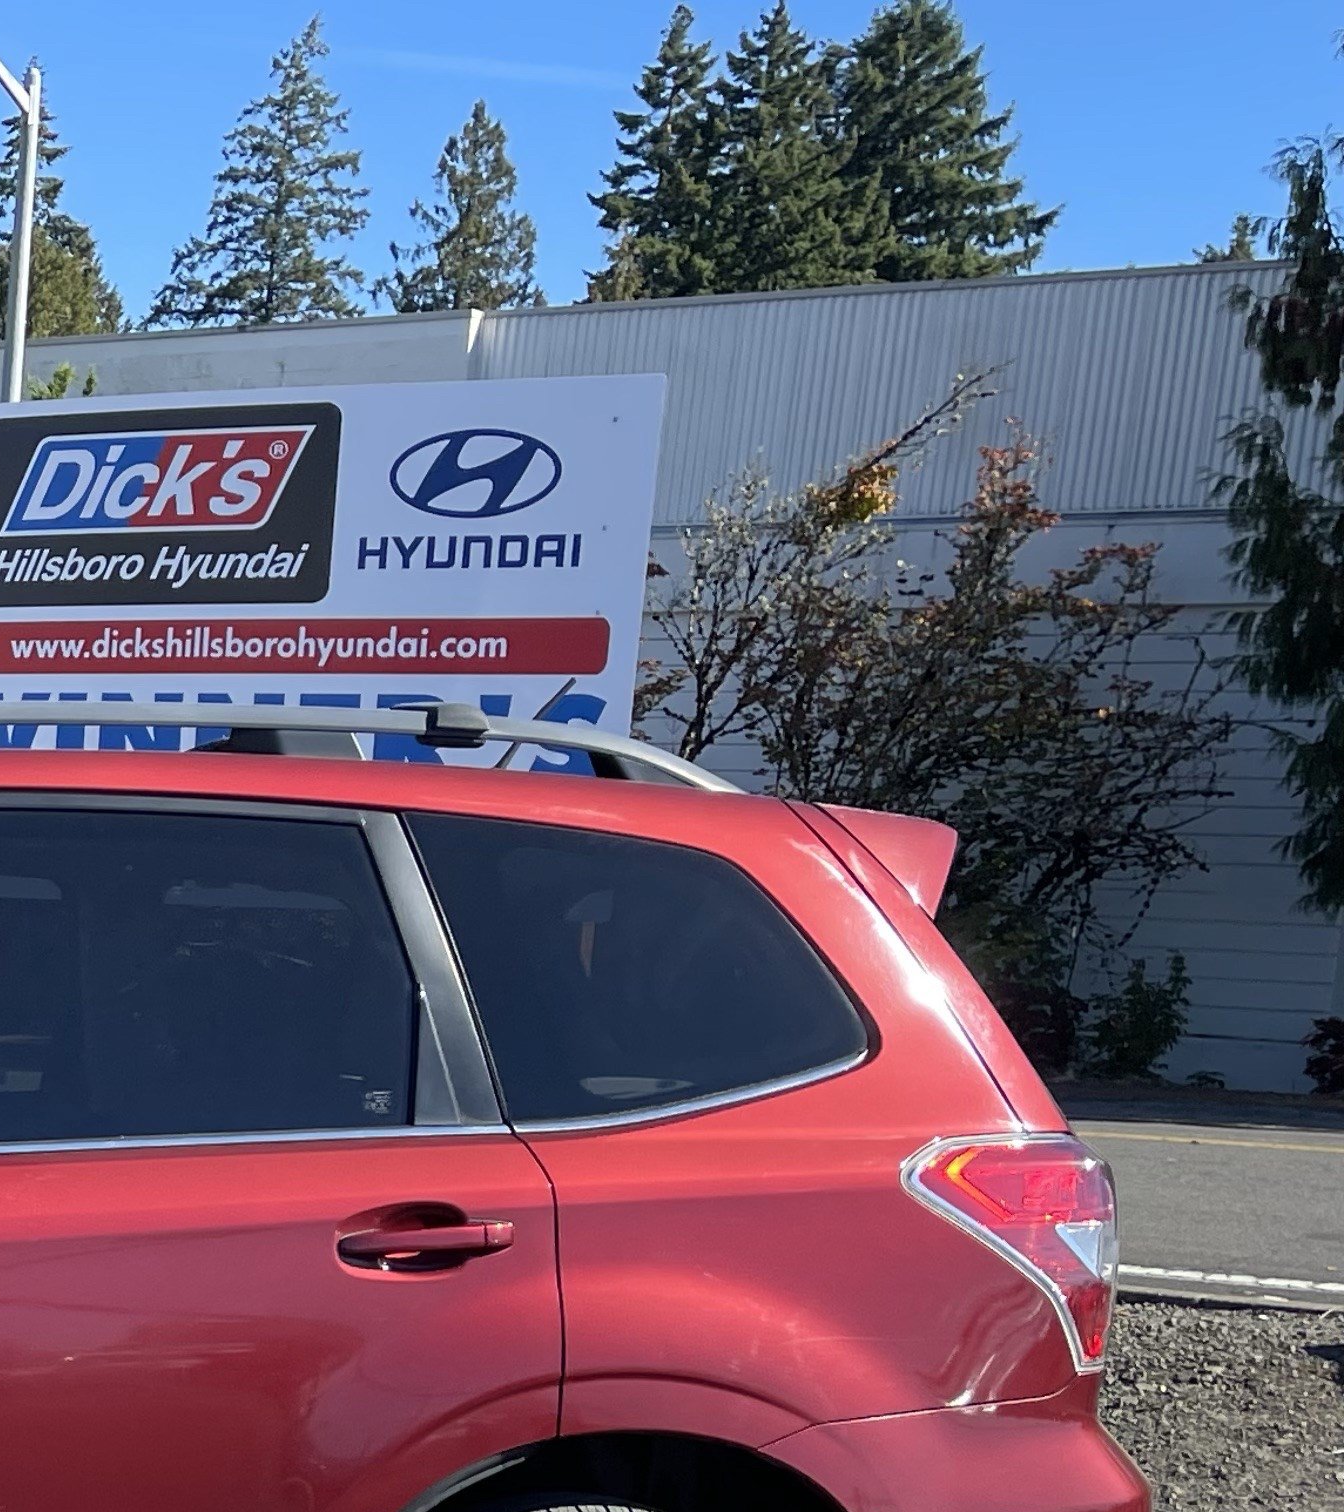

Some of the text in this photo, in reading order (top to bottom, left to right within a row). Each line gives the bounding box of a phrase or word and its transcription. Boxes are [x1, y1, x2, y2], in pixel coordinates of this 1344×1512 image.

[21, 439, 272, 522] Dick's
[148, 541, 311, 590] Hyundai
[357, 533, 582, 570] HYUNDAI
[10, 625, 508, 667] www.dickshillsborohyundai.com
